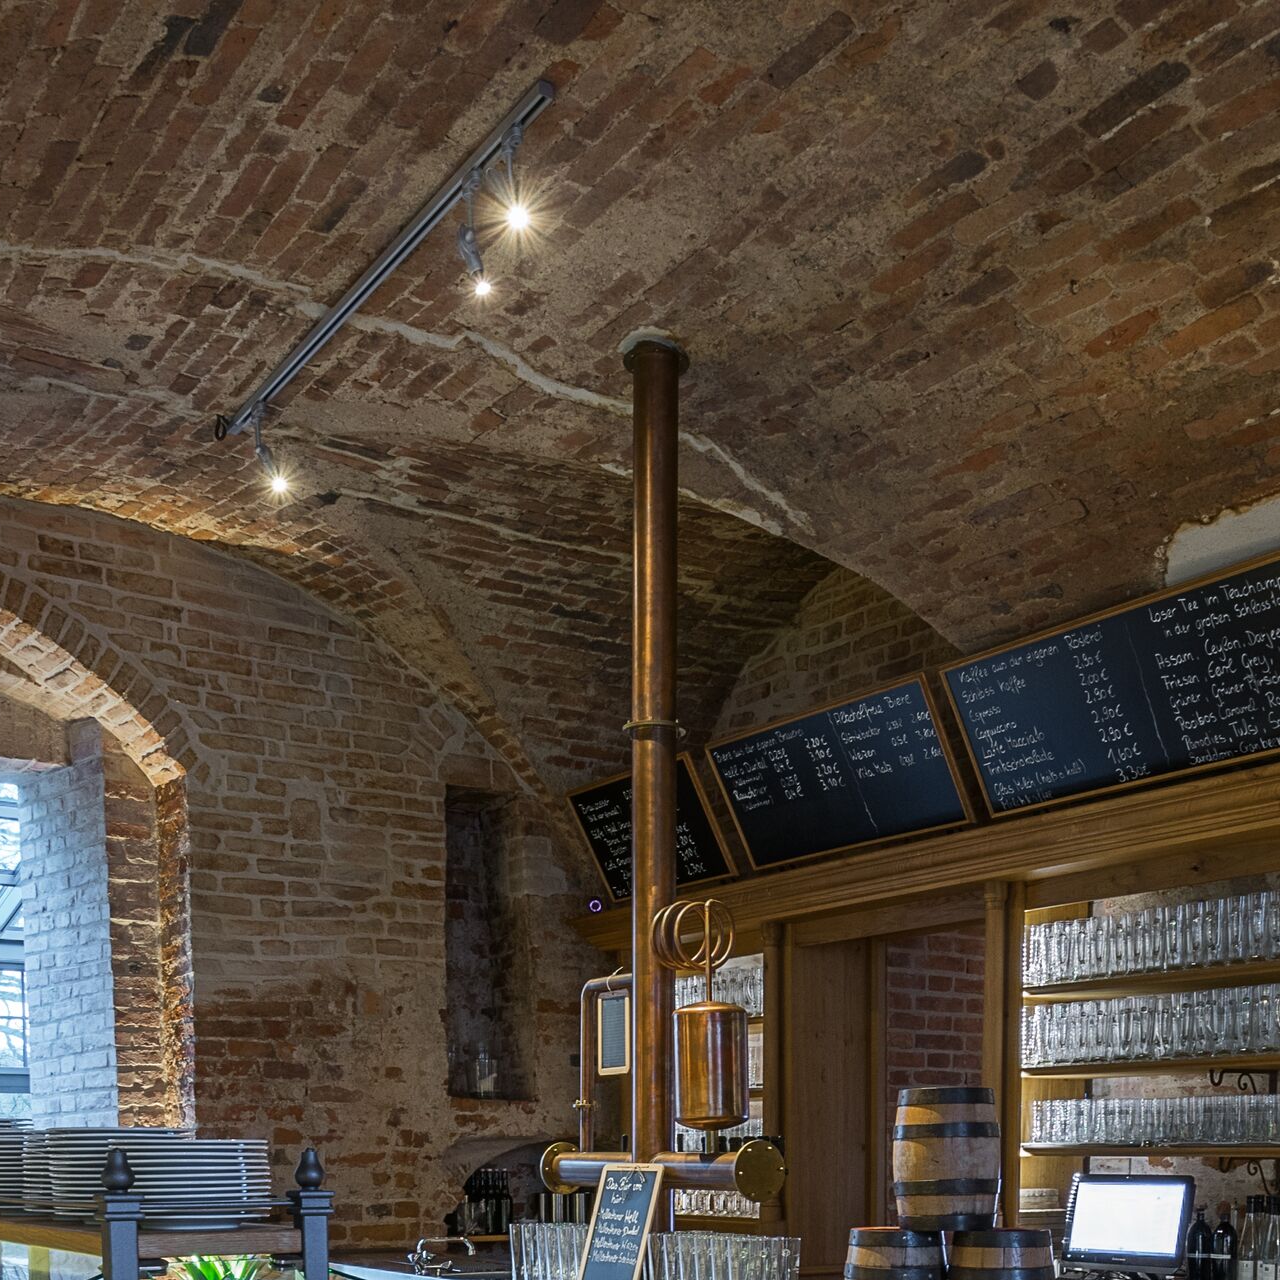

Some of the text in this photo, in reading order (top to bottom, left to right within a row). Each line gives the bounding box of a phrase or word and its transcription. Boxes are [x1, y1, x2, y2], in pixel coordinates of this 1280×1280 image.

[1148, 607, 1176, 623] Loser
[1177, 598, 1198, 613] Tee
[1175, 622, 1190, 635] der
[1195, 613, 1231, 636] großen
